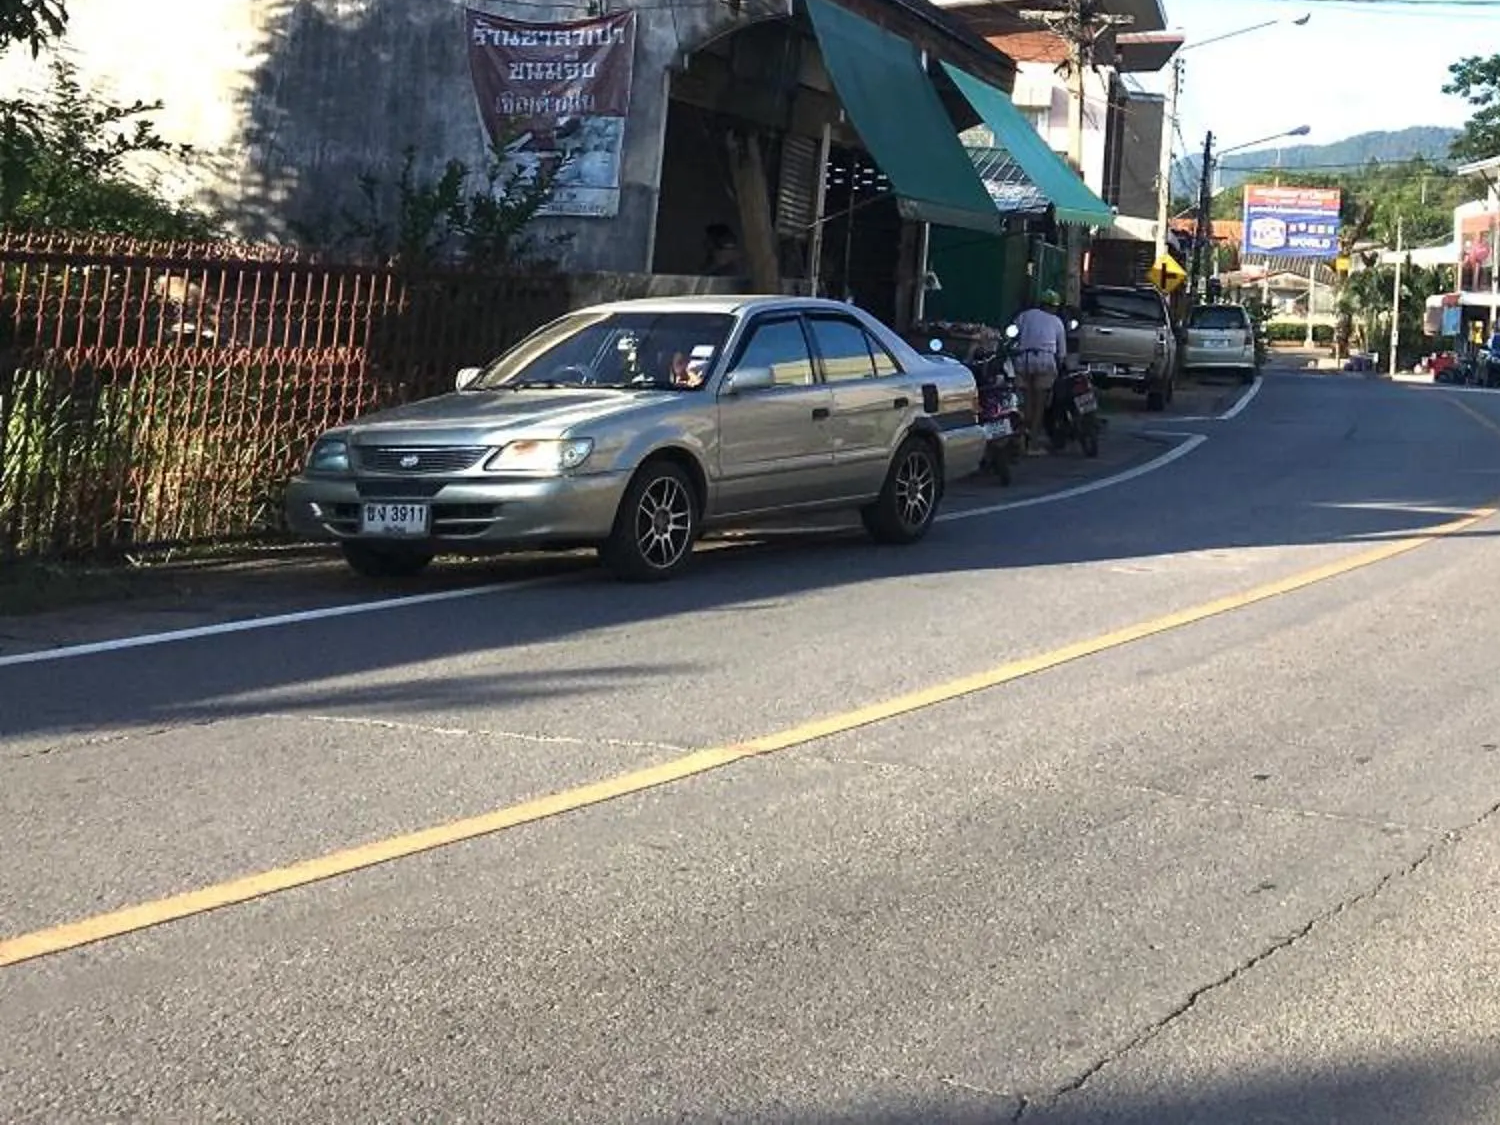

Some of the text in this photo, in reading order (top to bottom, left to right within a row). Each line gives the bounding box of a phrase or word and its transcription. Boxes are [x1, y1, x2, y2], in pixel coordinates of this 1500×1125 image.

[508, 51, 597, 80] ขนมจีบ
[391, 506, 423, 522] 3911
